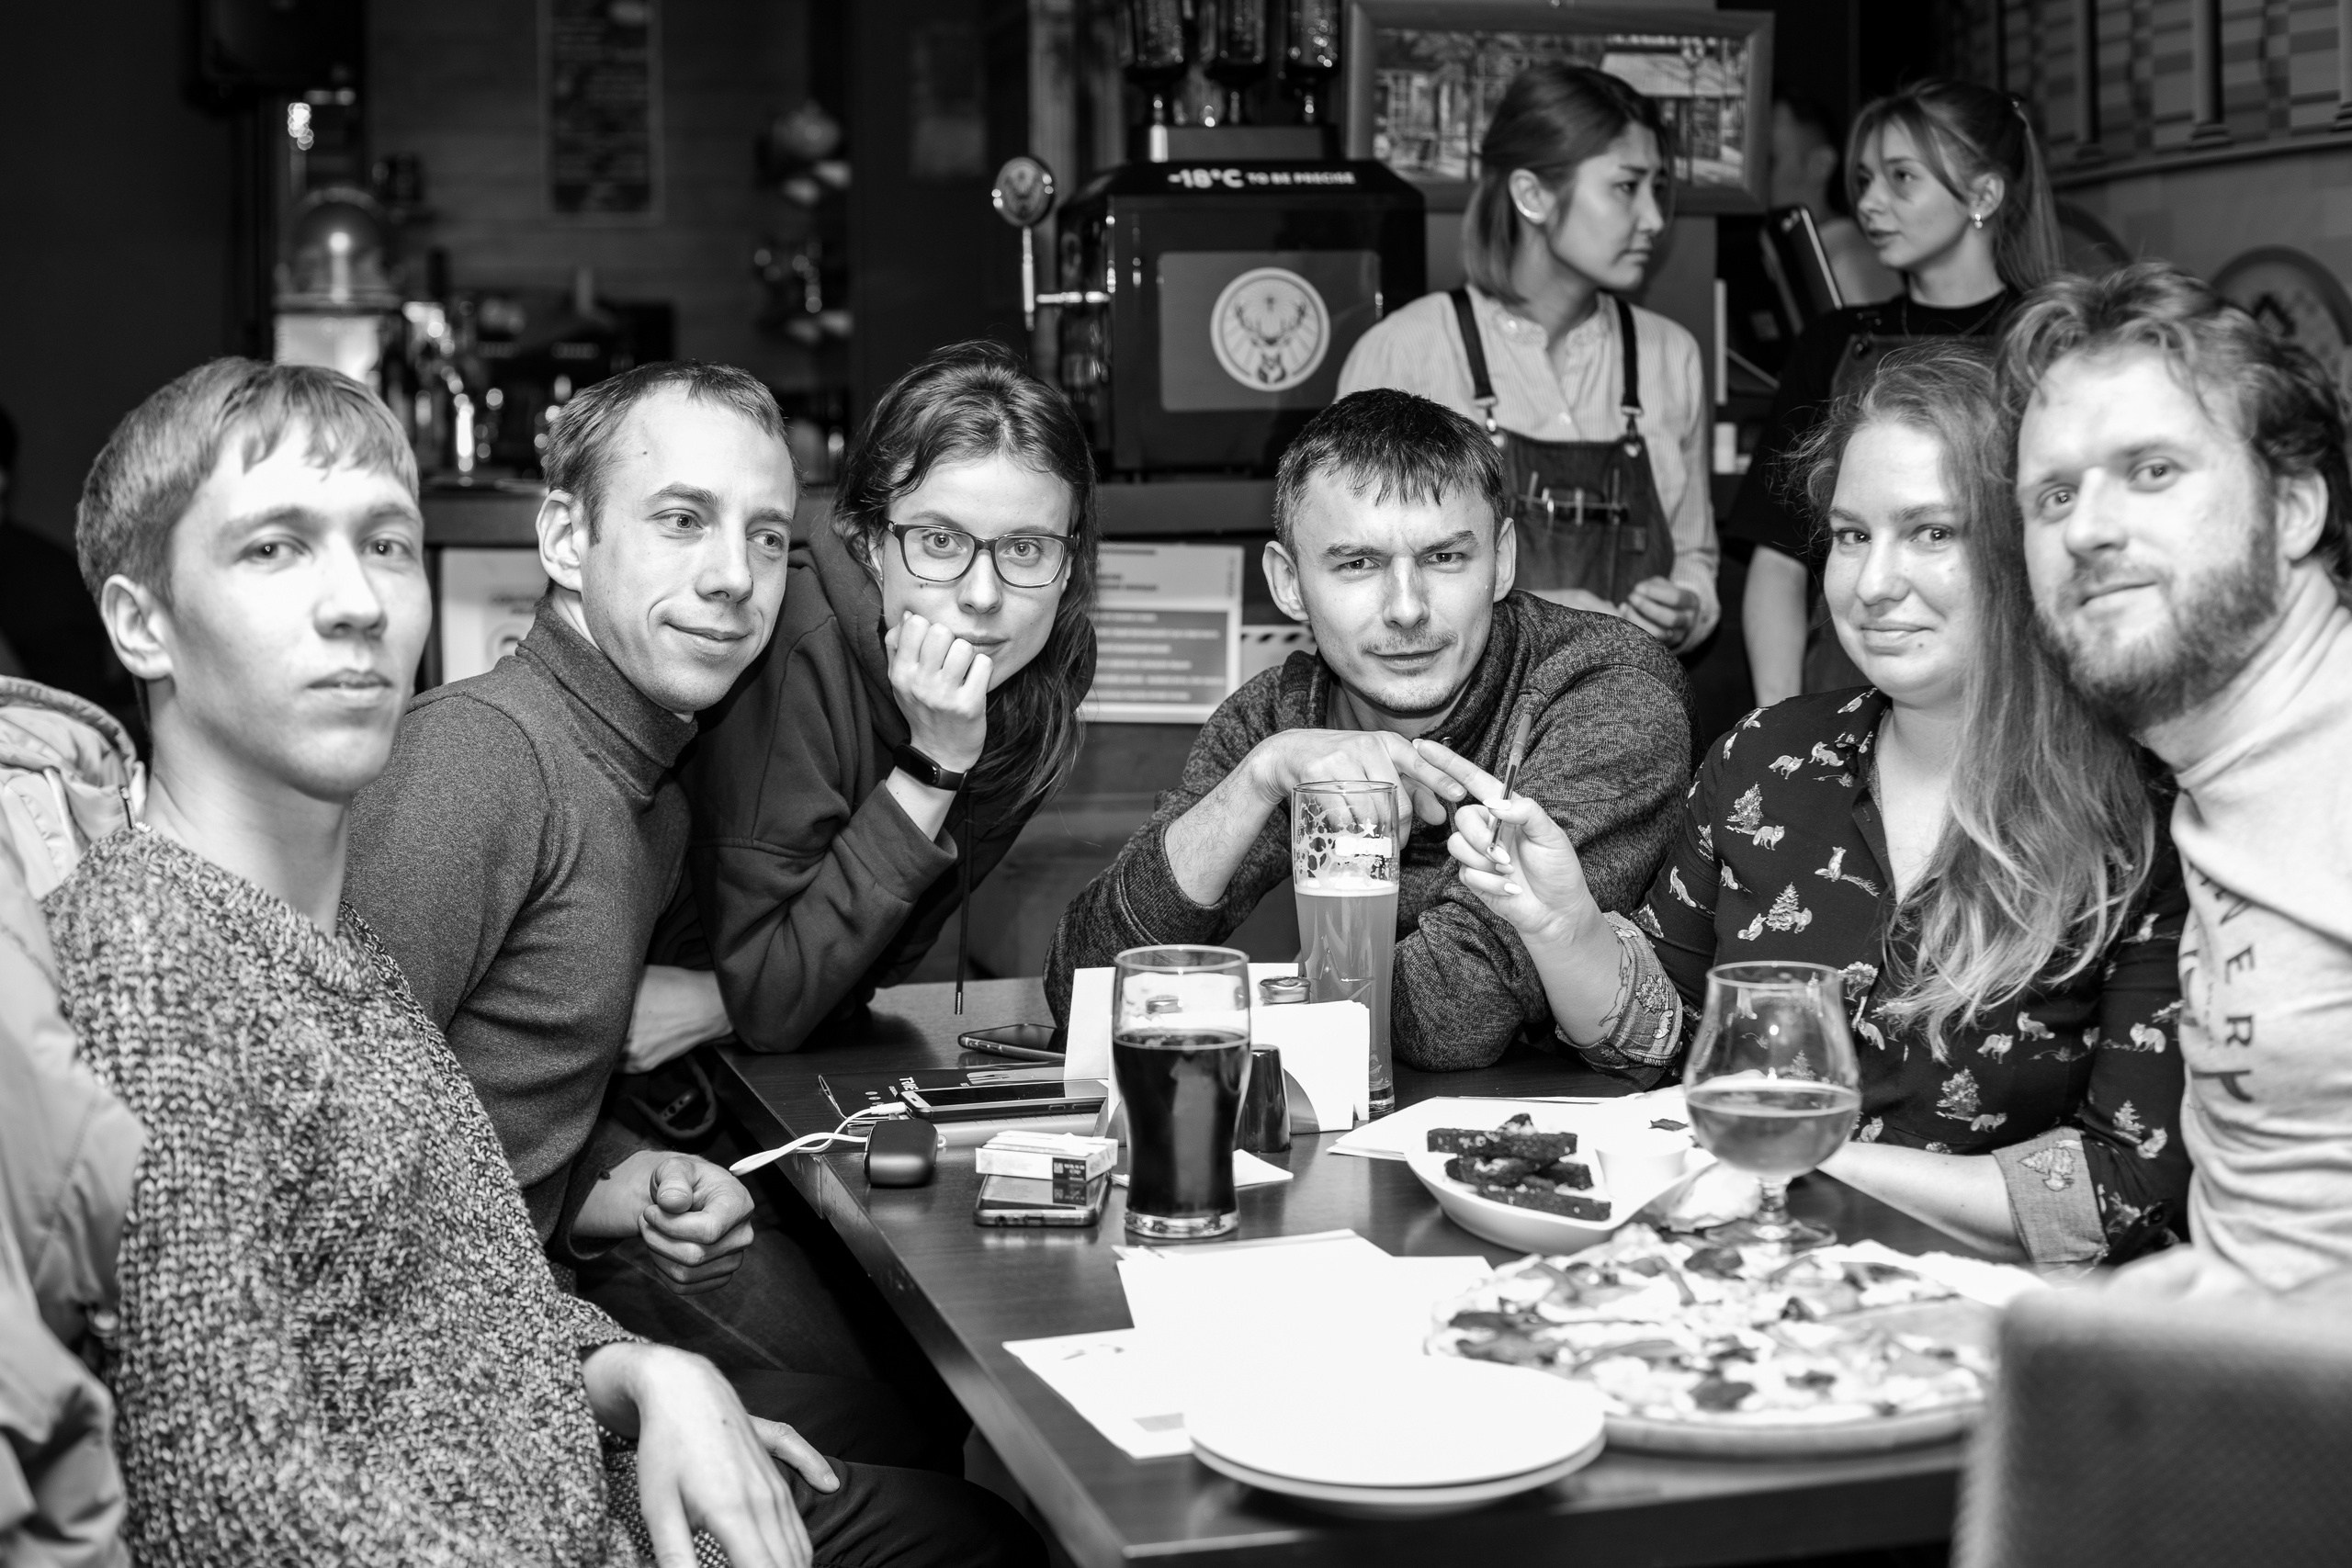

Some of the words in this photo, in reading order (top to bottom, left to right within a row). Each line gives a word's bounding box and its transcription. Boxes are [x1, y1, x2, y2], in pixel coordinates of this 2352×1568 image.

[1246, 172, 1270, 185] TO
[1271, 172, 1292, 185] BE
[1293, 172, 1356, 185] PRECISE
